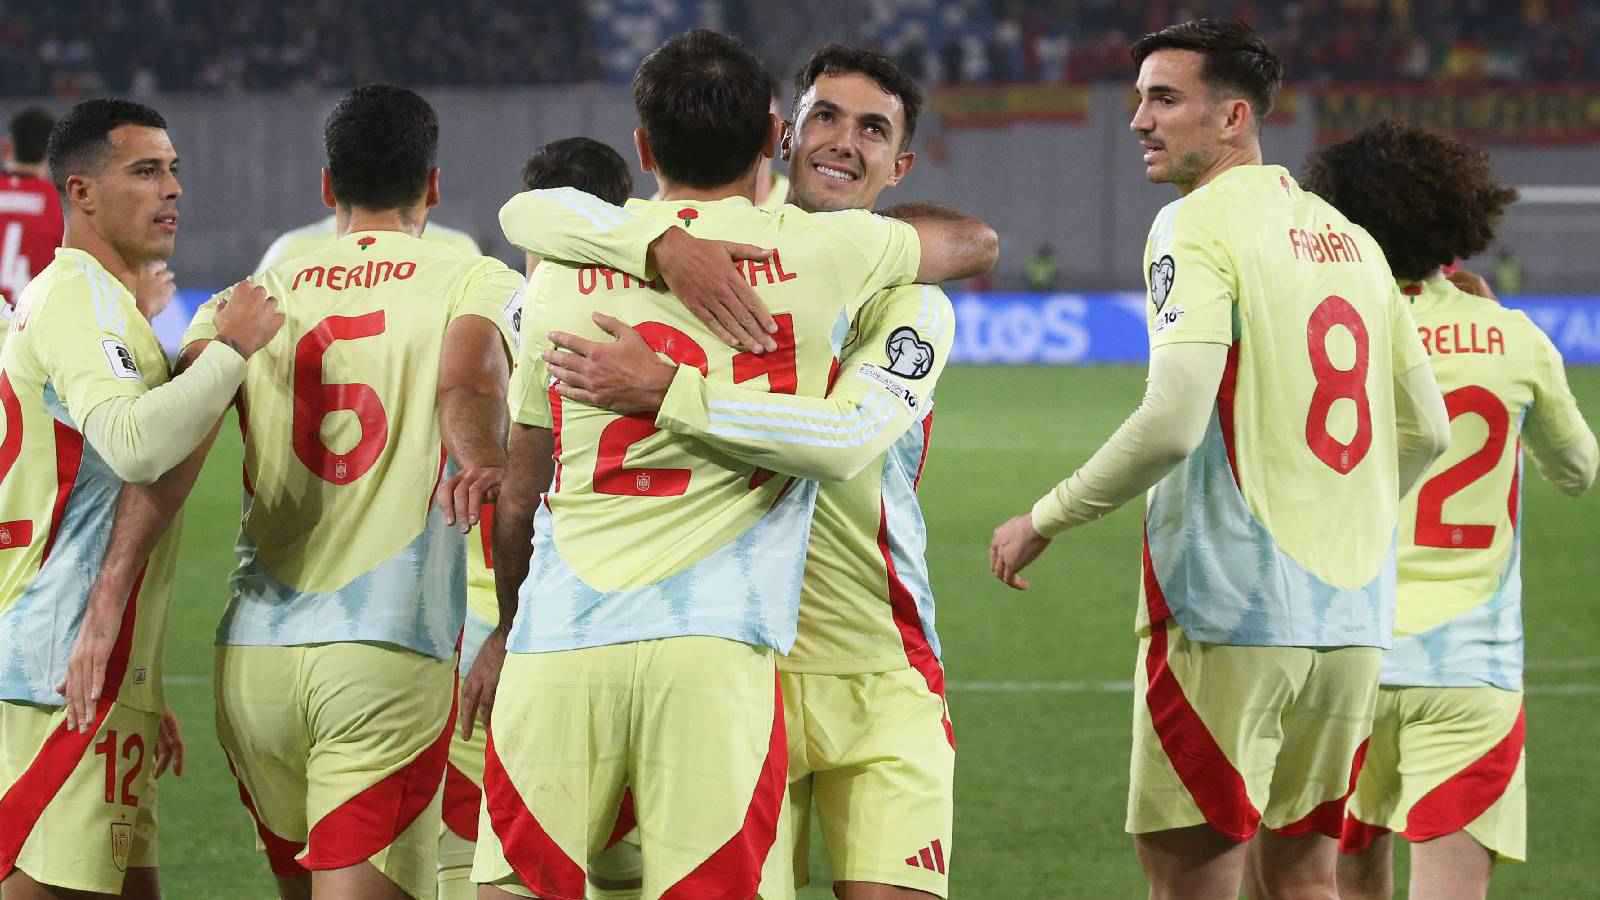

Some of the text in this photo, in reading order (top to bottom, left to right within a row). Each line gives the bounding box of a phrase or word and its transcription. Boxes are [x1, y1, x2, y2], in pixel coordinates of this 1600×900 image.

[292, 260, 417, 291] MERINO
[1288, 223, 1363, 264] FABIÁN
[292, 309, 389, 486] 6
[1305, 294, 1373, 476] 8
[1414, 384, 1510, 550] 2
[94, 729, 145, 808] 12
